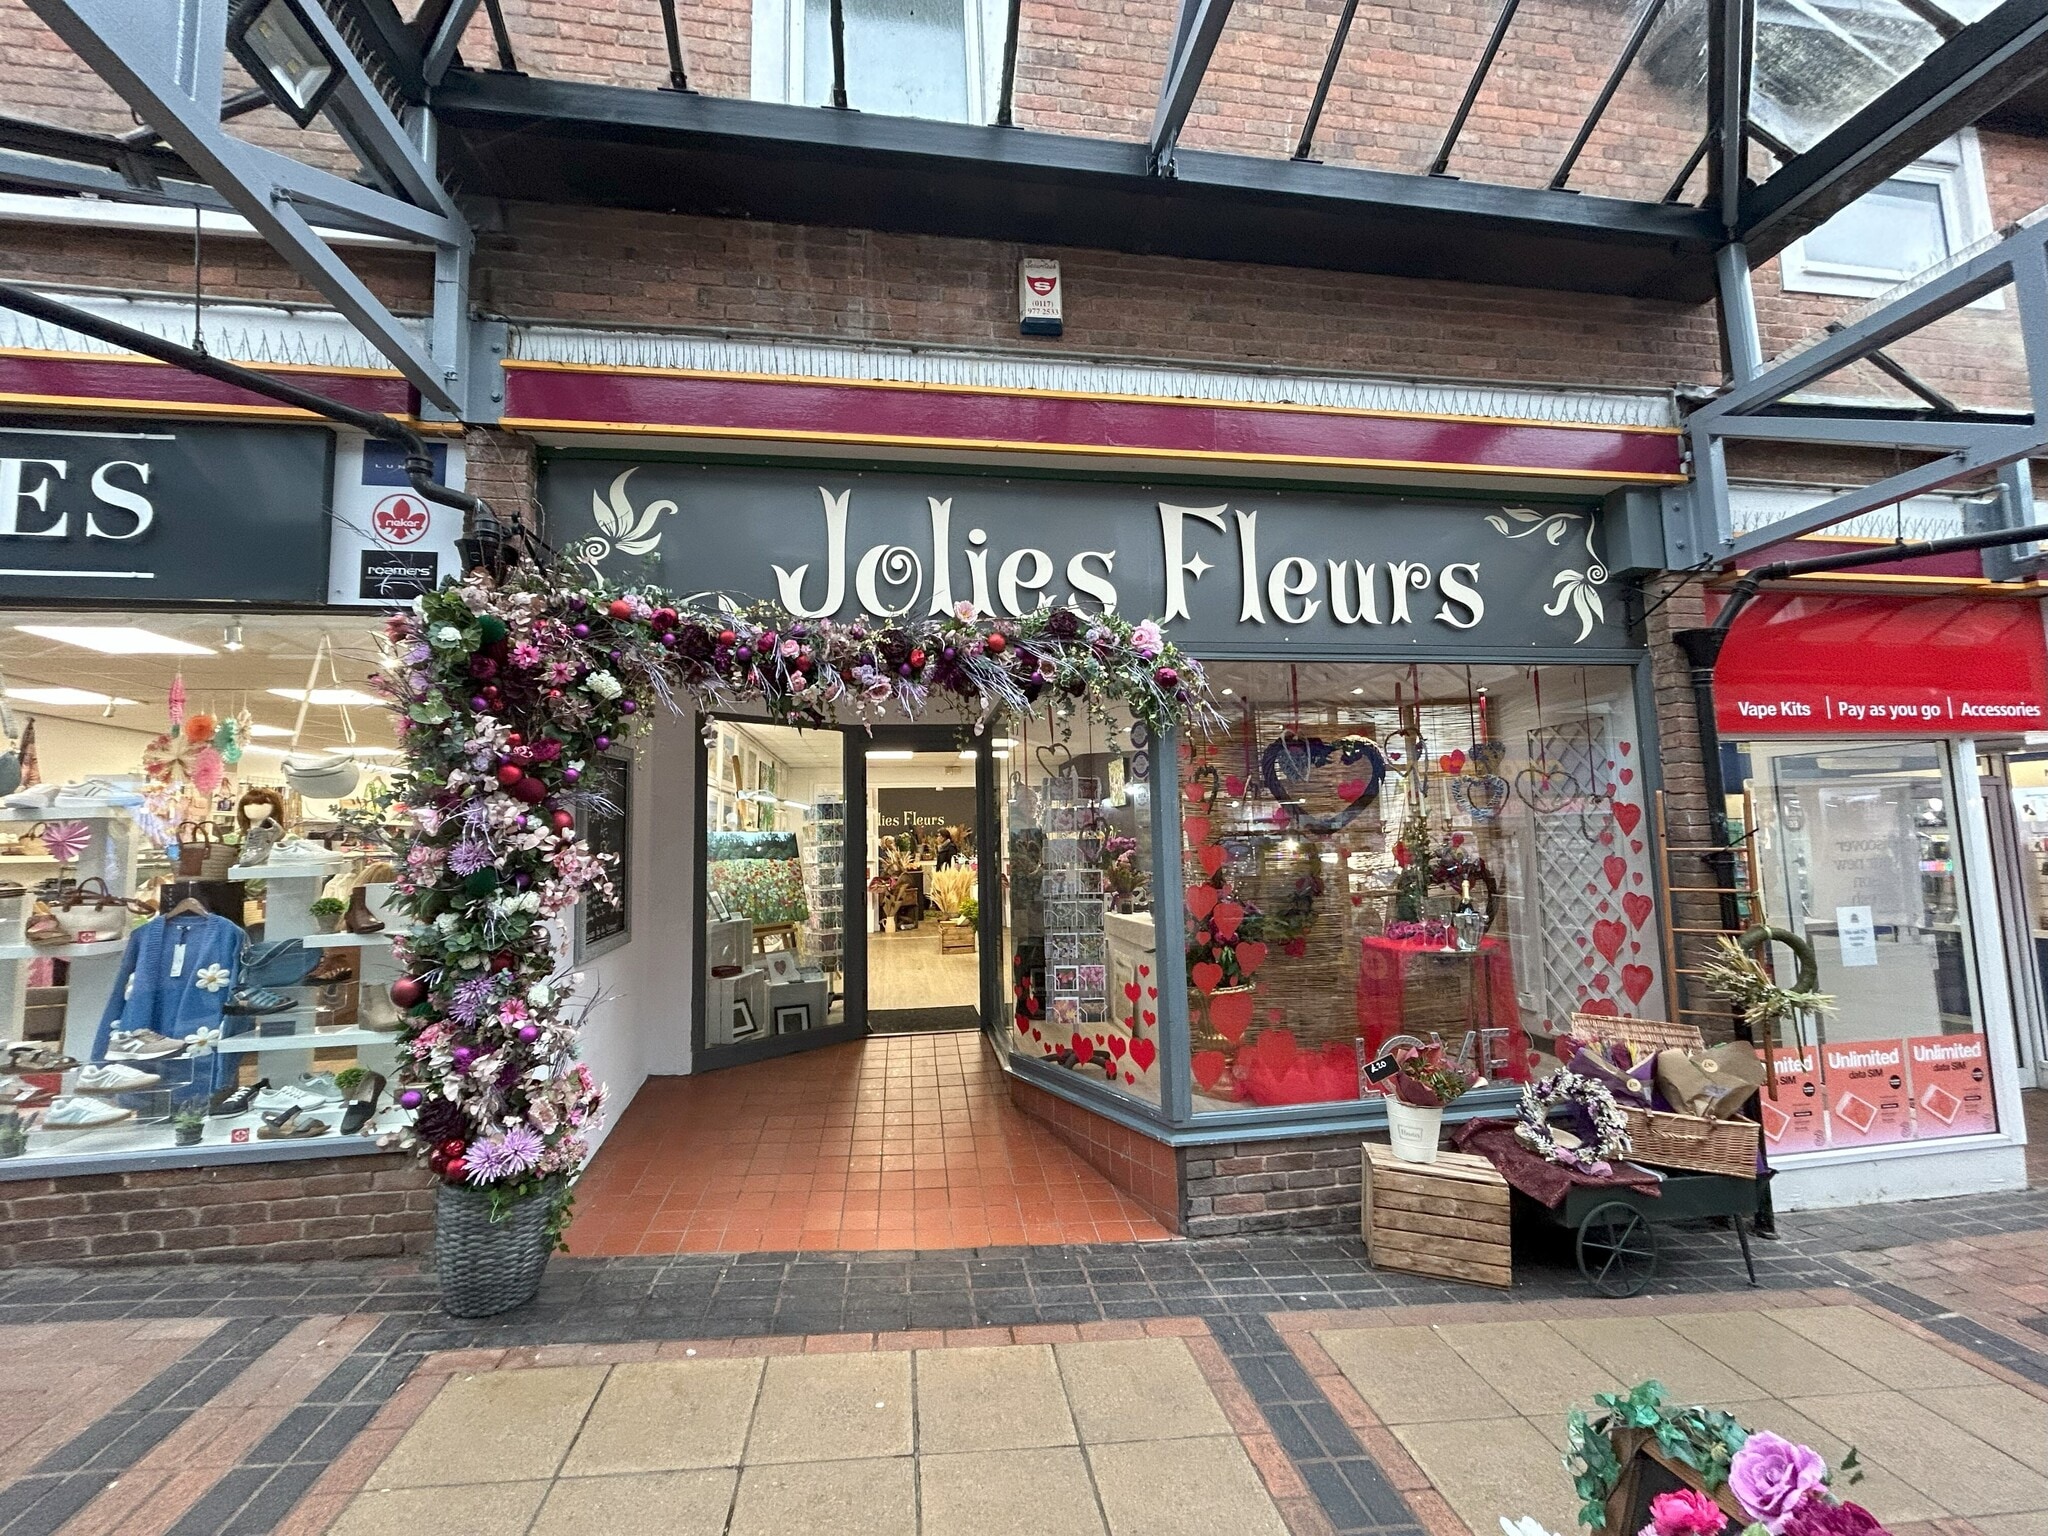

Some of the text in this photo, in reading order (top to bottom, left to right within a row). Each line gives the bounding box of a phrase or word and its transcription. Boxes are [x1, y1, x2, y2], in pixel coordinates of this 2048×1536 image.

[0, 458, 153, 539] ES
[771, 486, 1485, 629] Jolies Fleurs
[1738, 701, 1811, 719] Vape Kits
[1838, 702, 1941, 720] Pay as you go
[1961, 702, 2041, 716] Accessories
[878, 811, 945, 827] lies Fleurs
[1828, 1047, 1900, 1069] Unlimited
[1913, 1042, 1981, 1061] Unlimited
[1371, 1060, 1387, 1073] £20
[1849, 1069, 1883, 1079] data SIM
[1933, 1062, 1966, 1072] data SIM
[1780, 1076, 1797, 1085] SIM
